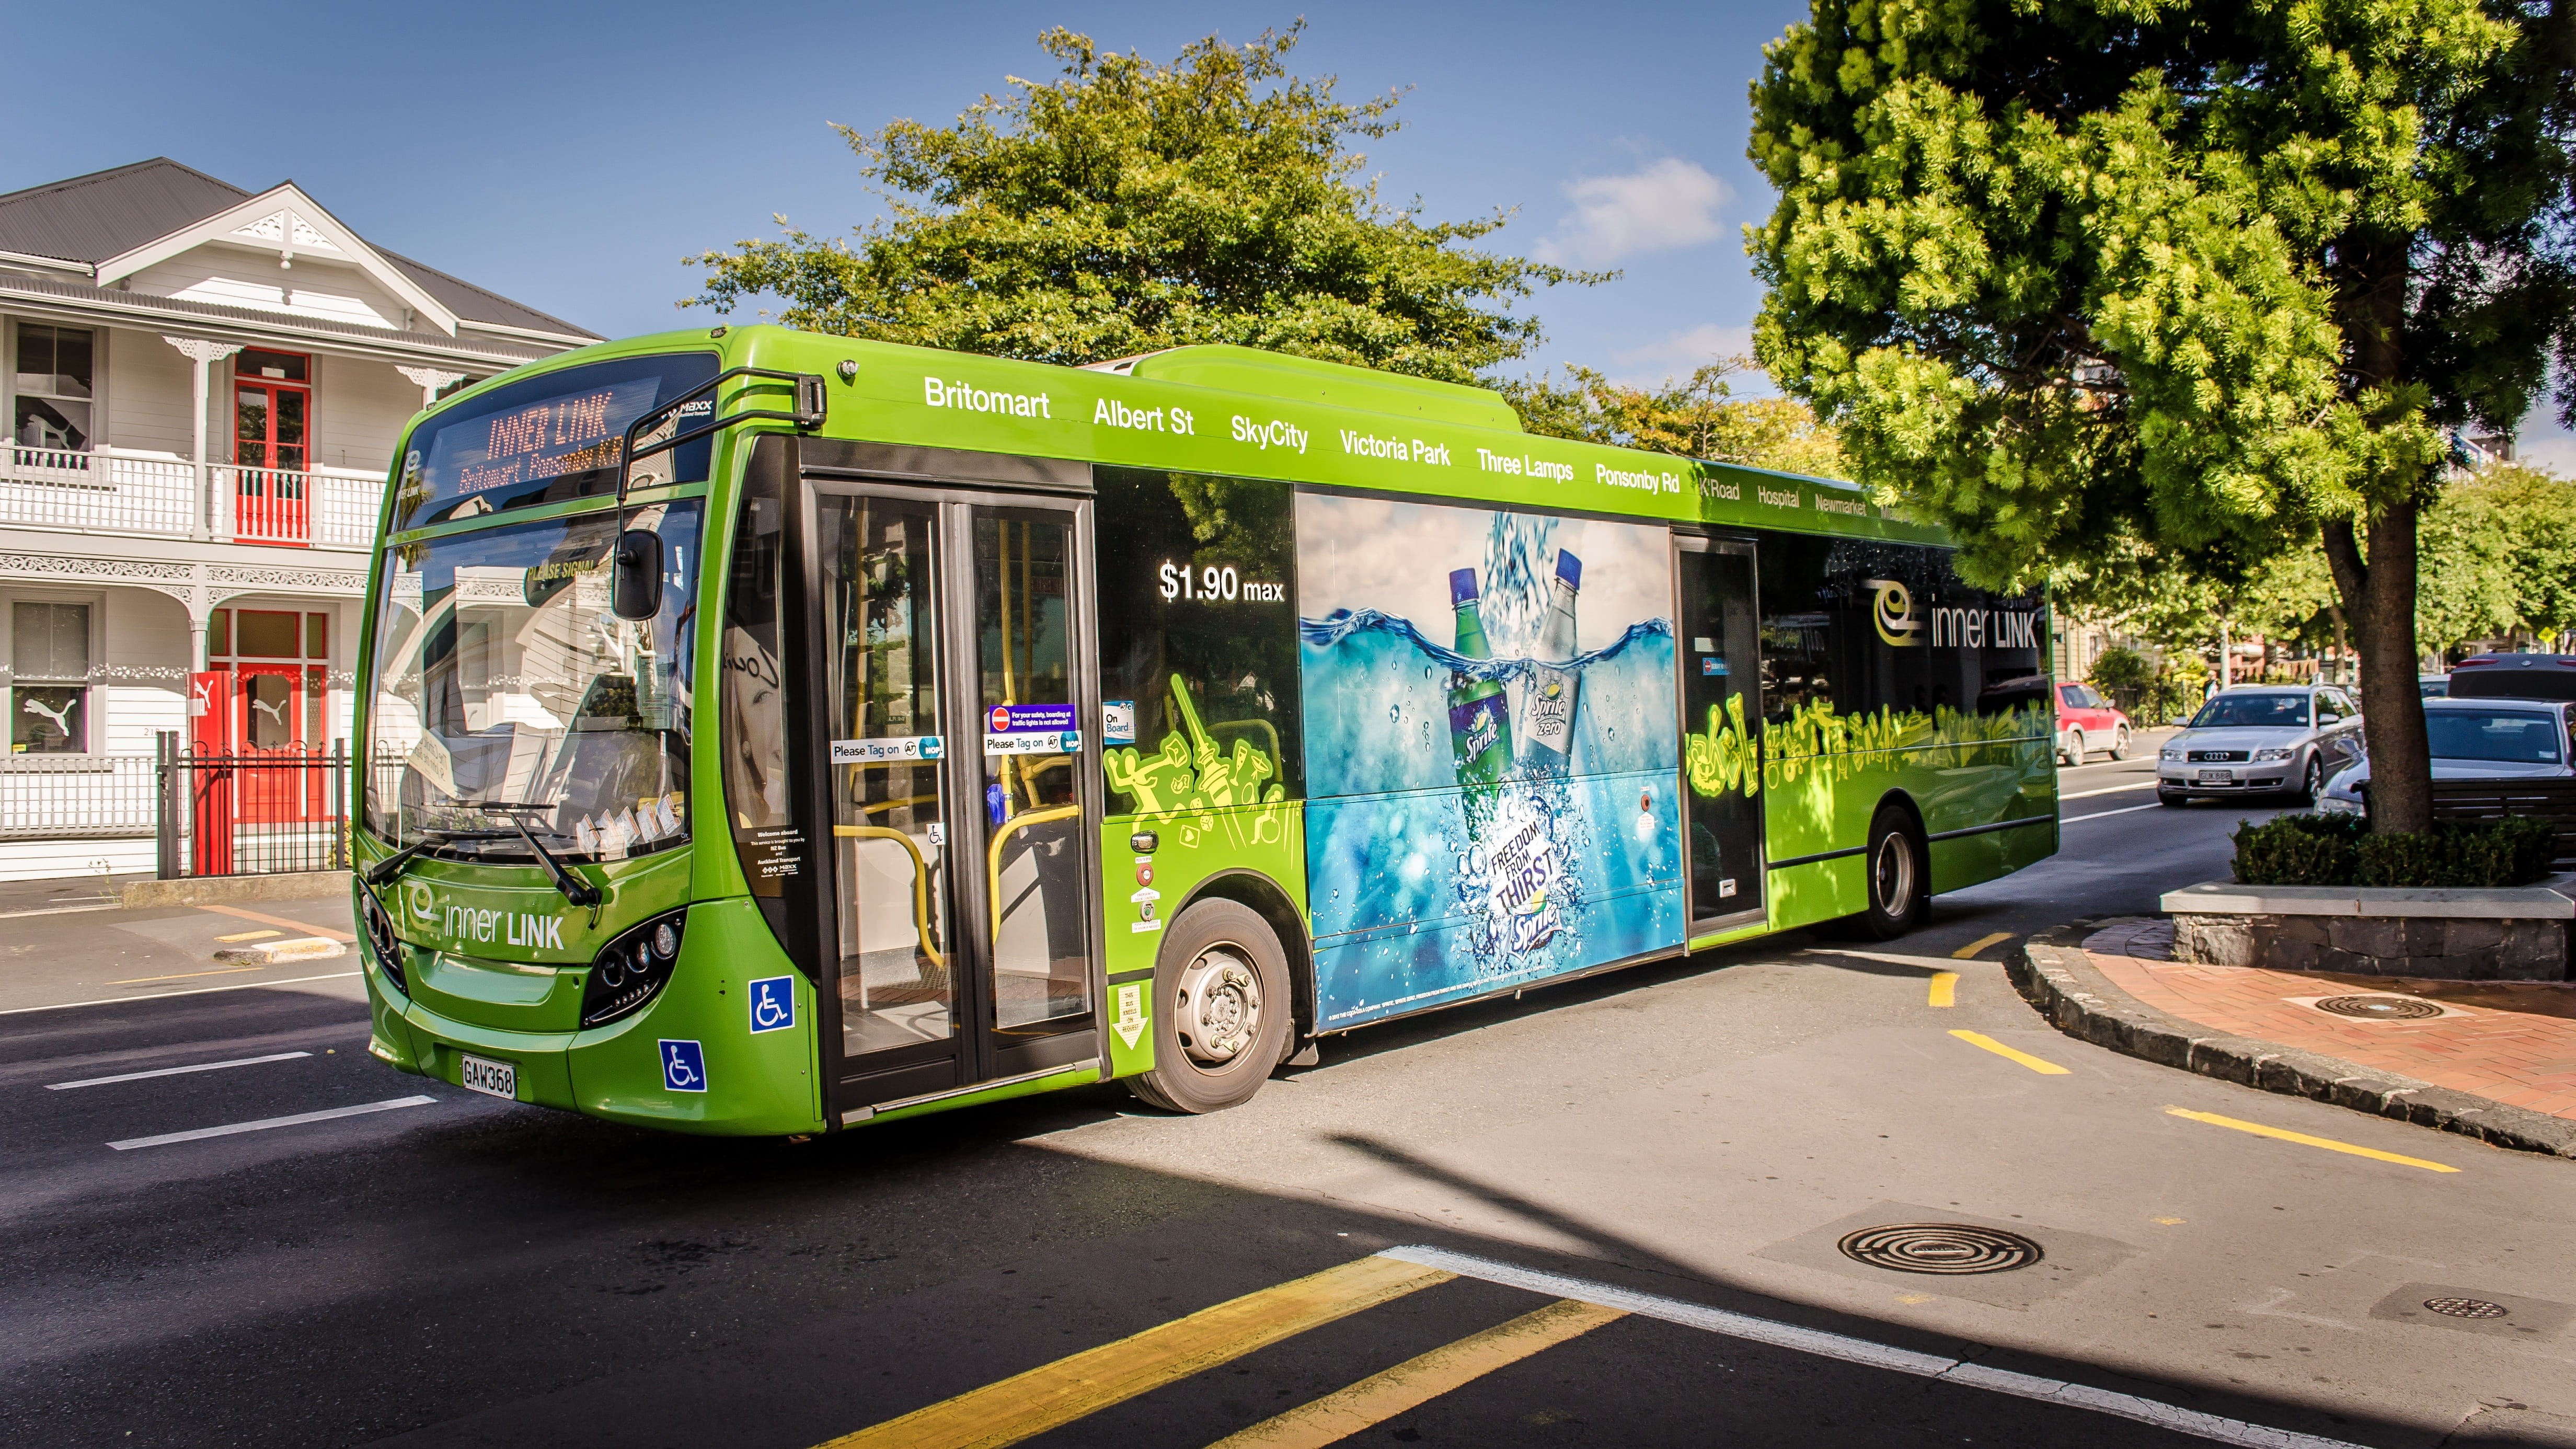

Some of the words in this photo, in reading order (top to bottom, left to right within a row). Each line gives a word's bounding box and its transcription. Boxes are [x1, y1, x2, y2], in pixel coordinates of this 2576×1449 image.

[924, 376, 1051, 419] Britomart
[487, 407, 549, 460] INNER
[555, 392, 612, 445] LINK
[1094, 398, 1163, 431] Albert
[1170, 407, 1194, 435] St
[1232, 415, 1308, 454] SkyCity
[1339, 429, 1408, 461] Victoria
[1412, 439, 1451, 466] Park
[1477, 448, 1521, 475] Three
[1525, 454, 1573, 484] Lamps
[1596, 463, 1659, 495] Ponsonby
[1662, 472, 1680, 493] Rd
[1758, 485, 1799, 509] Hospital
[1815, 493, 1867, 516] Newmarket
[528, 562, 560, 581] PLEASE
[562, 560, 594, 578] SIGNAL
[1159, 559, 1237, 603] $1.90
[1244, 583, 1284, 602] max
[1932, 594, 1989, 648] inner
[1994, 611, 2038, 648] LINK
[1106, 714, 1118, 723] On
[1531, 693, 1566, 722] Sprite
[987, 738, 1014, 749] Please
[1016, 738, 1030, 750] Tag
[1107, 722, 1128, 732] Board
[1466, 720, 1498, 763] Sprite
[1537, 722, 1561, 736] zero
[834, 745, 865, 757] Please
[868, 744, 884, 757] Tag
[887, 746, 899, 754] on
[1491, 821, 1540, 875] FREEDOM
[1505, 849, 1532, 881] FROM
[1496, 847, 1553, 915] THIRST
[445, 894, 502, 942] inner
[508, 912, 564, 949] LINK
[1512, 902, 1557, 950] Sprite
[1122, 1024, 1138, 1033] REQUEST
[464, 1060, 512, 1094] GAW368
